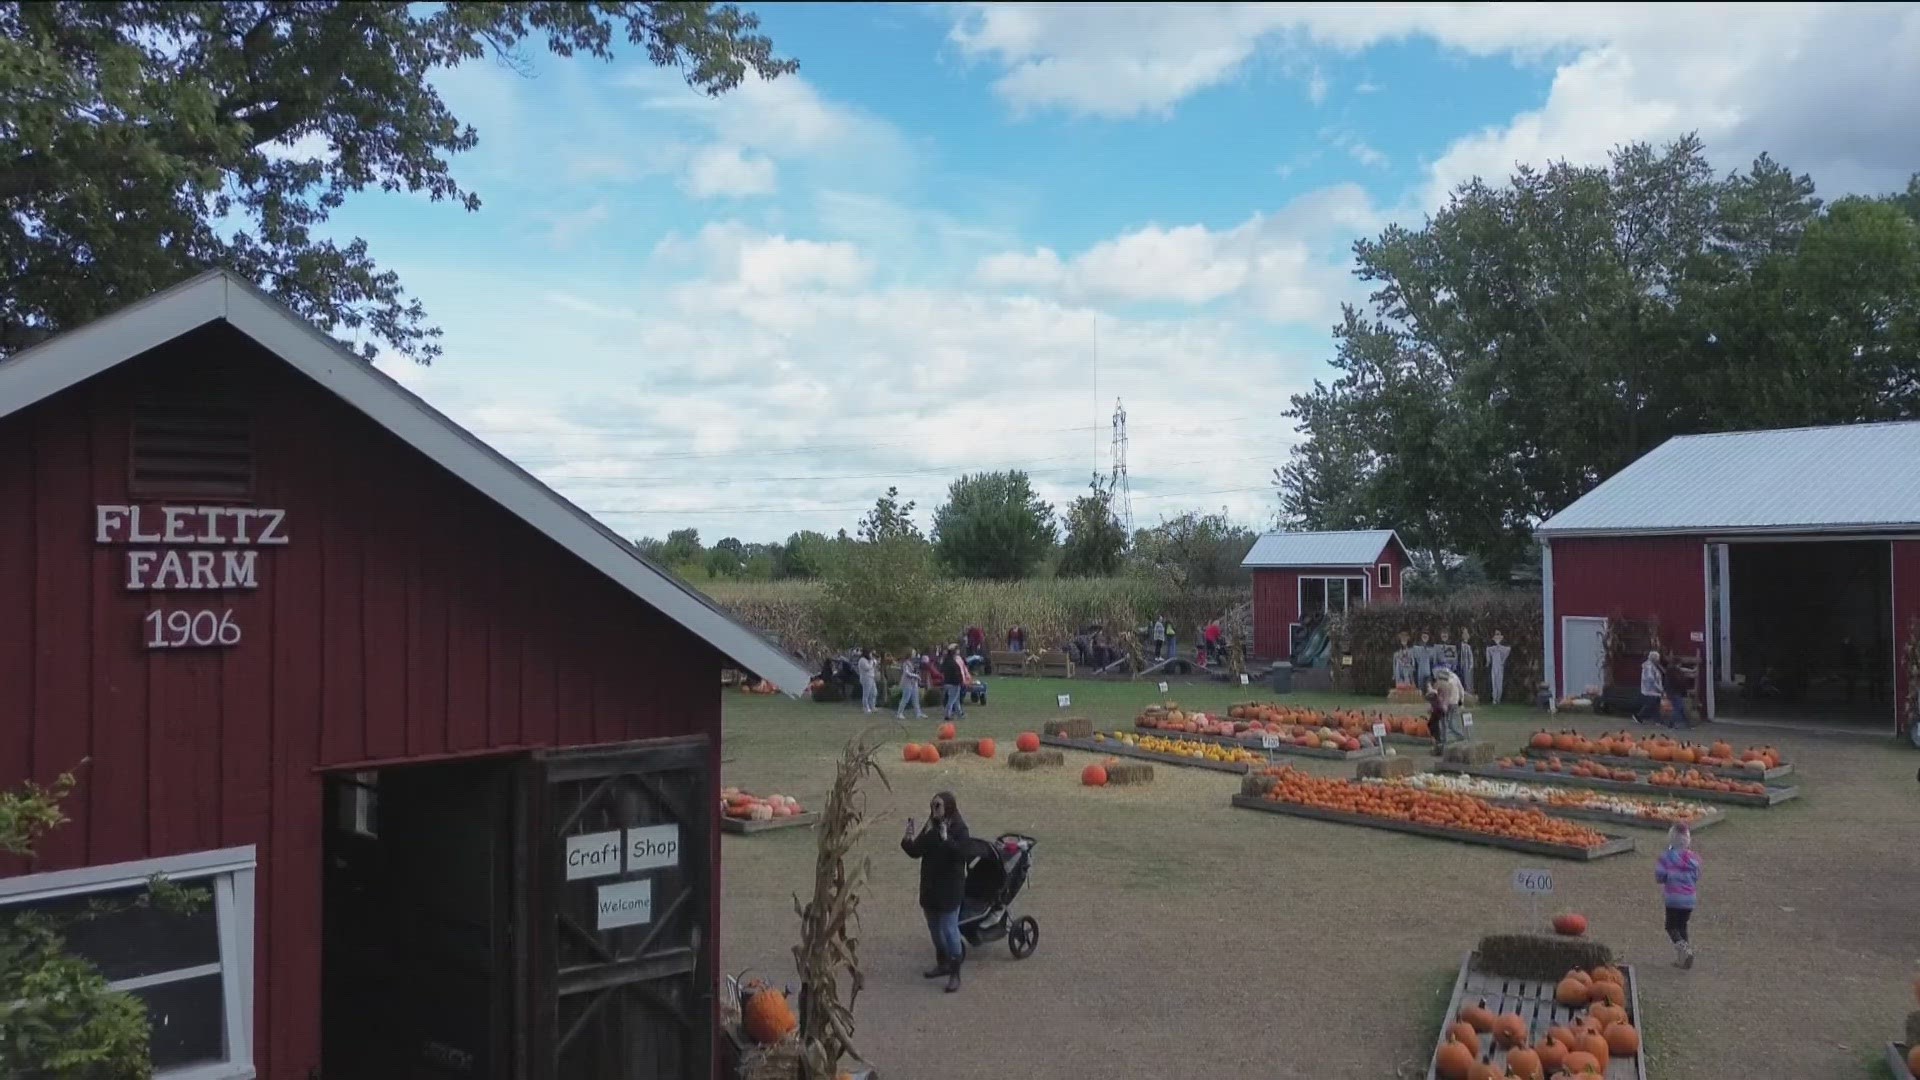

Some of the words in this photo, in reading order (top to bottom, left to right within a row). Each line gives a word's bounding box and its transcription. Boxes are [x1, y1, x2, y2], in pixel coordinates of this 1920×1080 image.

[96, 505, 289, 544] FLEITZ
[127, 550, 258, 589] FARM
[146, 609, 241, 648] 1906
[568, 843, 619, 867] Craft
[633, 838, 677, 859] Shop
[600, 899, 651, 914] Welcome
